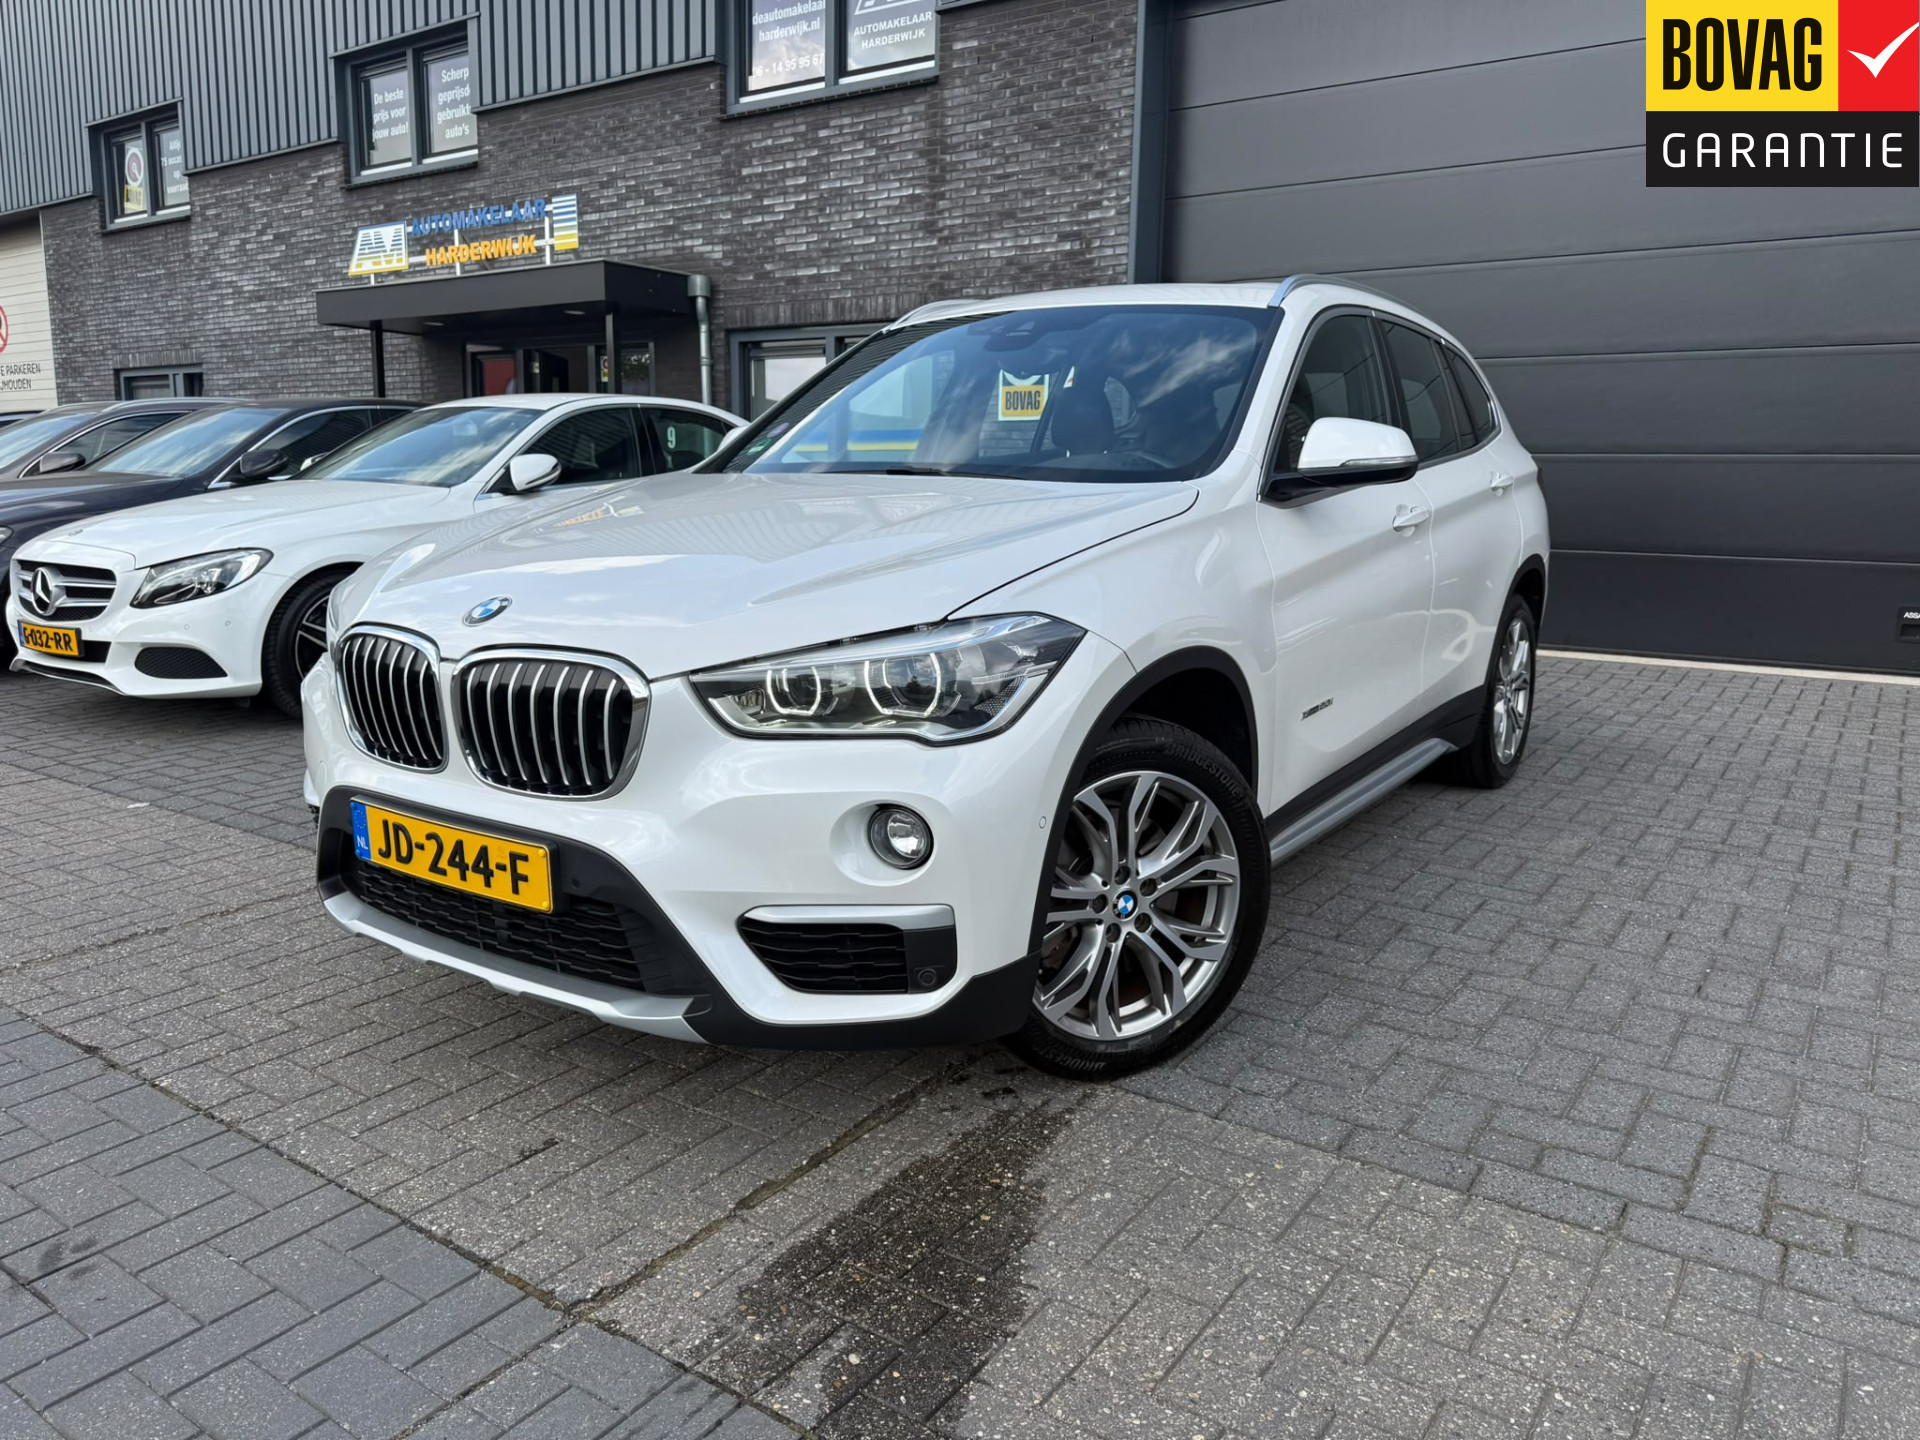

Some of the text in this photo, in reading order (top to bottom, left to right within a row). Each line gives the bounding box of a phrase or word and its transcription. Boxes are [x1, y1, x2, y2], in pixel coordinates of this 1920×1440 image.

[758, 17, 821, 42] harderwijk.nl
[853, 11, 932, 37] AUTOMAKELAAR
[861, 27, 926, 50] HARDERWIJK
[772, 62, 783, 74] 14
[785, 59, 796, 71] 95
[798, 56, 810, 68] 95
[812, 52, 824, 65] 67
[441, 67, 469, 83] Scherp
[374, 88, 404, 105] De beste
[373, 107, 406, 125] prijs voor
[390, 122, 409, 137] auto!
[445, 123, 470, 139] auto's
[412, 198, 547, 236] AUTOMAKELAAR
[425, 234, 538, 267] HARDERWIJK
[6, 363, 41, 376] PARKEREN
[1005, 390, 1041, 411] BOVAG
[666, 426, 677, 449] 9
[23, 627, 73, 651] G-032-RR
[356, 818, 529, 896] NL JD-244-F
